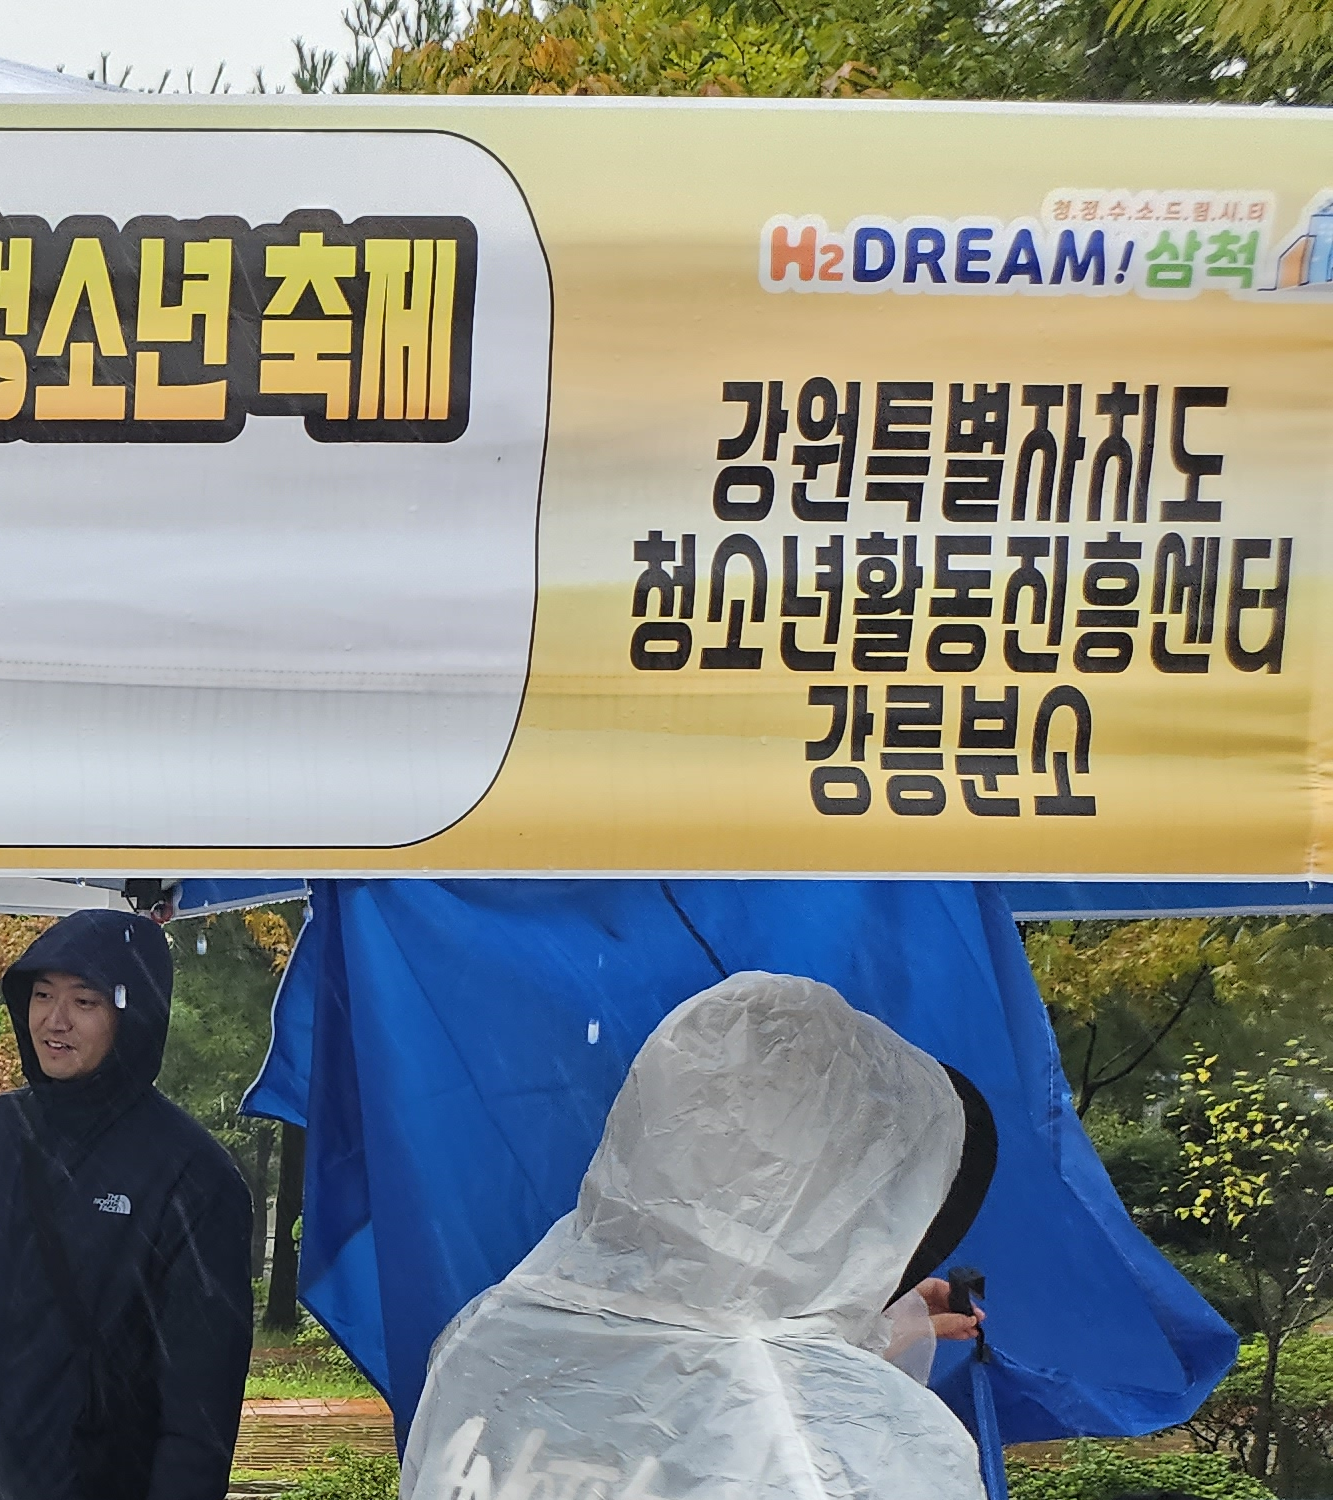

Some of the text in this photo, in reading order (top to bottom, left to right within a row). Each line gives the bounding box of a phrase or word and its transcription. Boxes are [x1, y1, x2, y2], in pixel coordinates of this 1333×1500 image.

[258, 231, 457, 421] 축제
[1145, 228, 1257, 290] 삼척
[713, 376, 1230, 525] 강원특별자치도
[630, 529, 1294, 675] 청소년활동진흥센터
[805, 685, 1097, 817] 강릉분소
